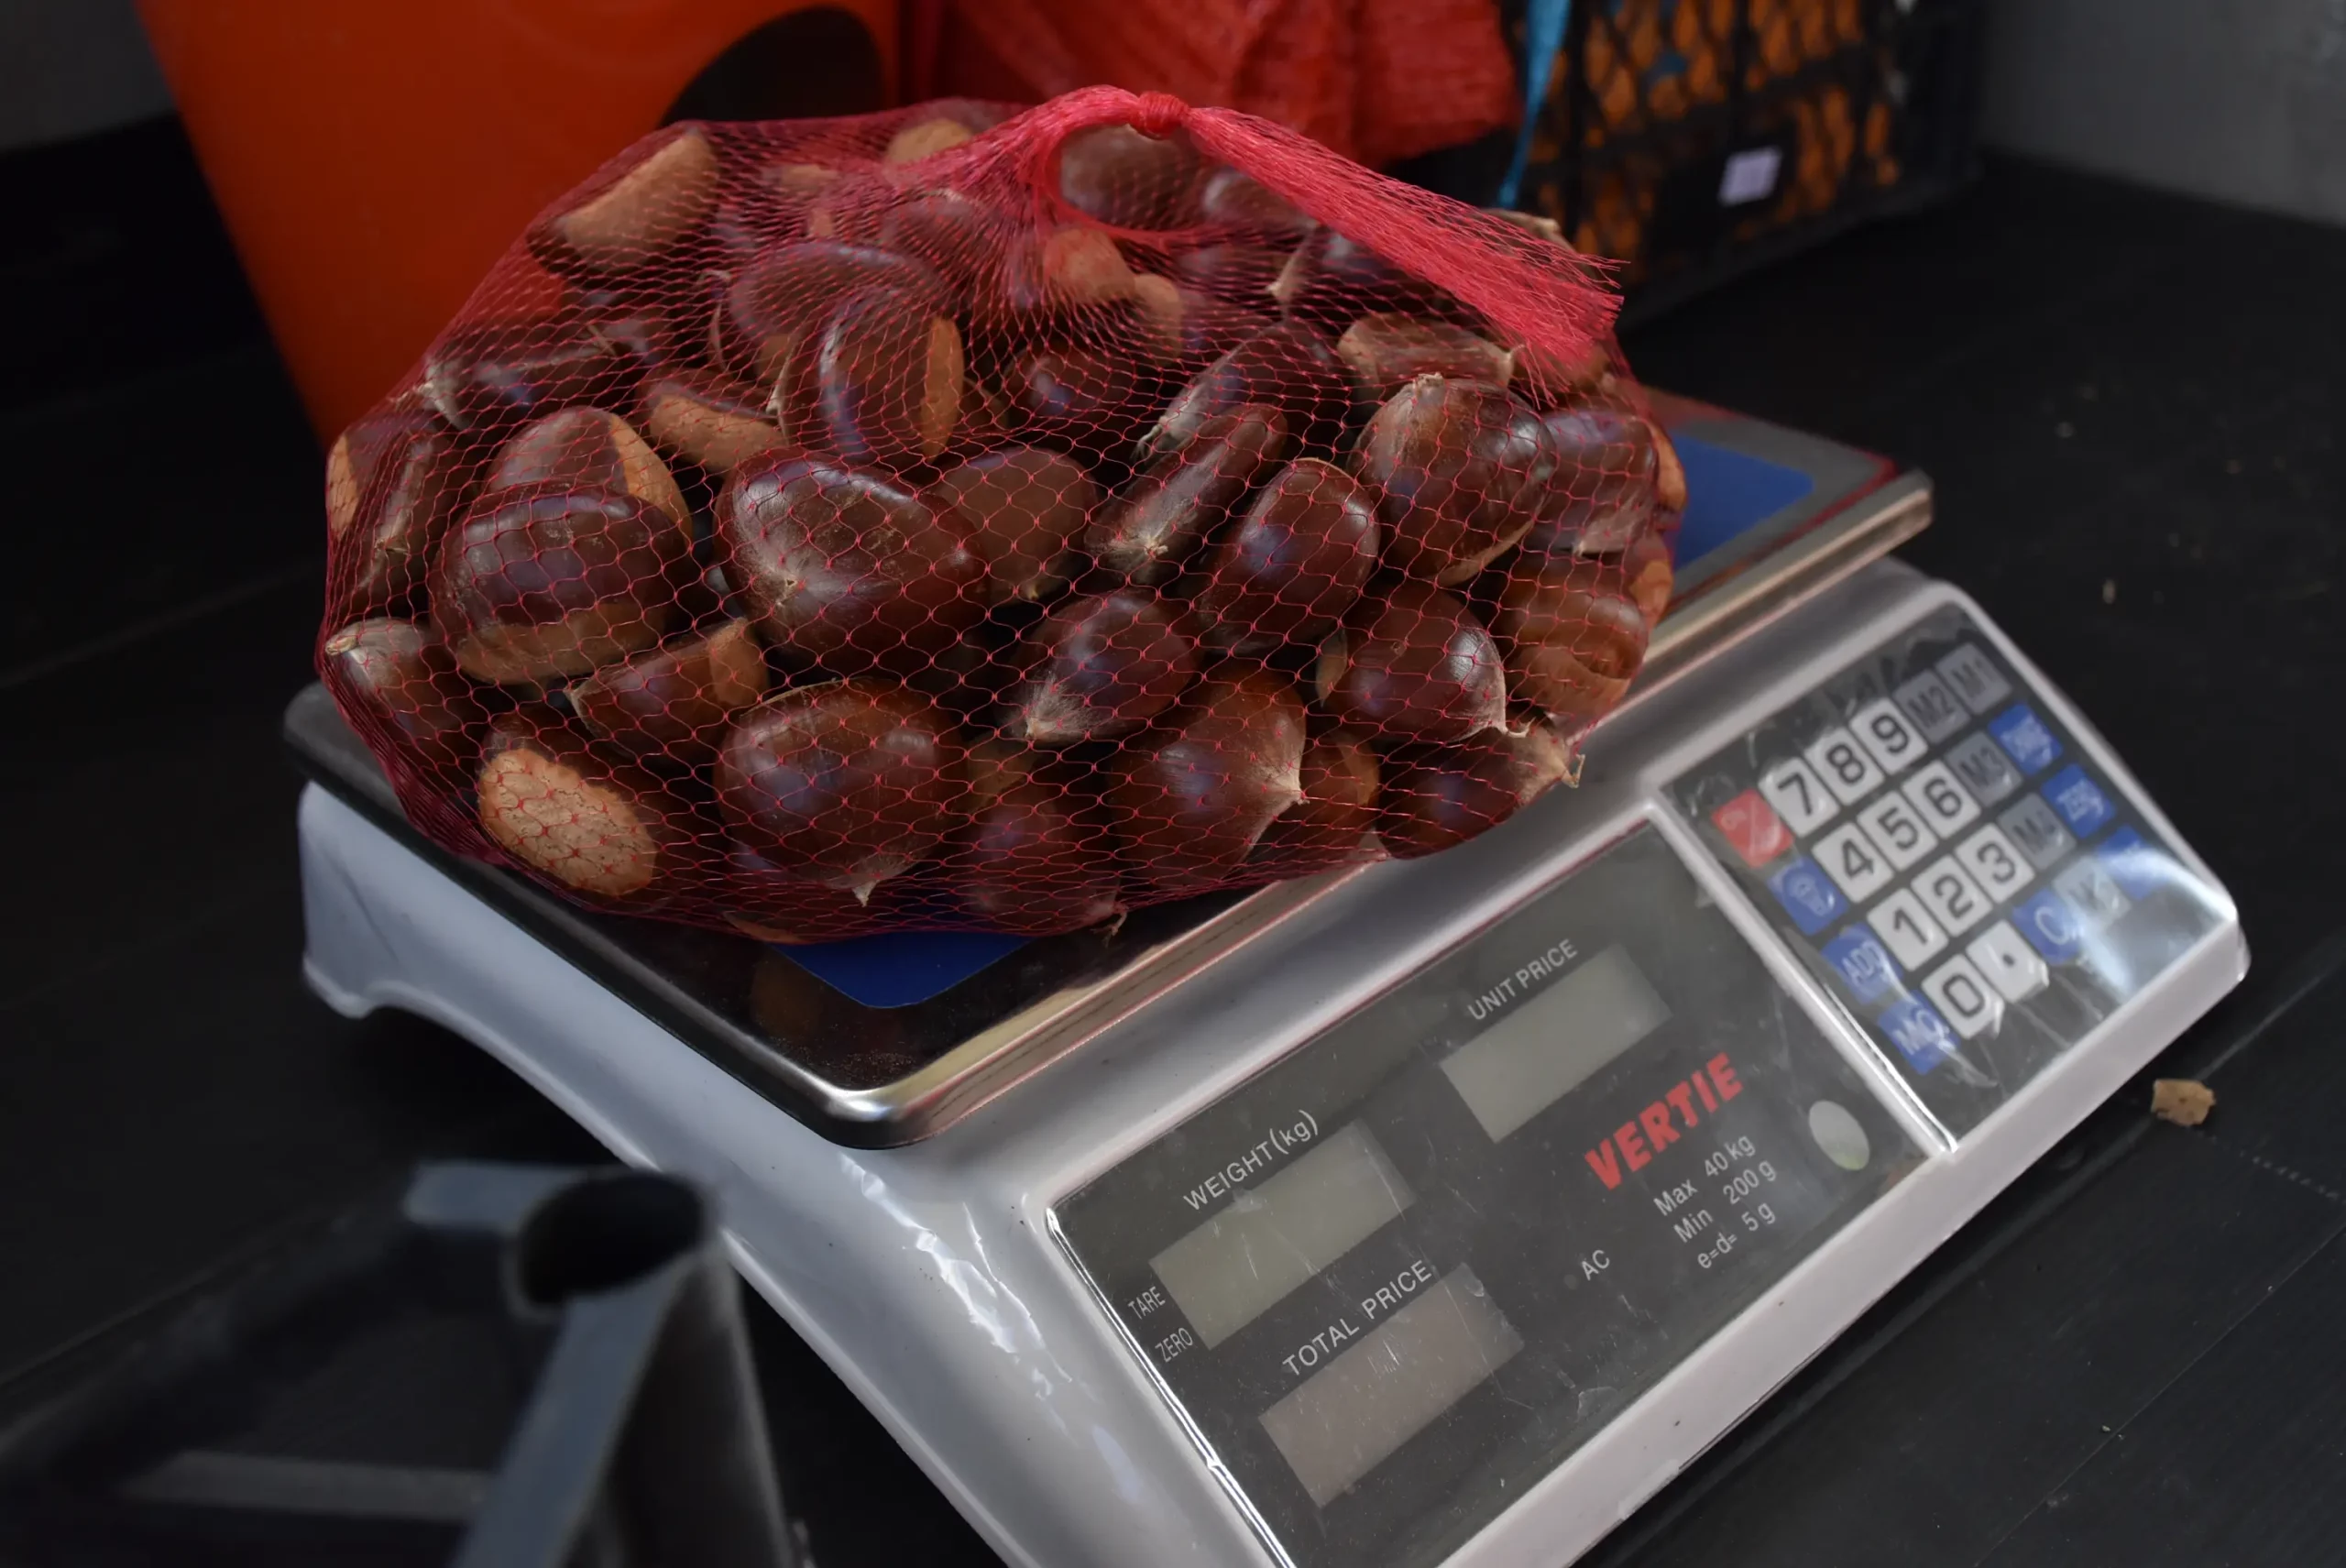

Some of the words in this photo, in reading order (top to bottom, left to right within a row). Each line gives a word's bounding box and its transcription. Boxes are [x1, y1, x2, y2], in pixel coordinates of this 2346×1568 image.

[1907, 685, 1955, 729] M2
[1871, 715, 1909, 755] 9
[1825, 743, 1865, 784] 8
[1958, 745, 2005, 787] M3
[1777, 772, 1813, 817] 7
[1924, 776, 1962, 819] 6
[1877, 806, 1918, 850] 5
[1841, 839, 1875, 878] 4
[1977, 839, 2016, 884] 3
[1933, 874, 1974, 920] 2
[1892, 906, 1928, 946] 1
[1467, 977, 1517, 1020] UNIT
[1515, 938, 1578, 989] PRICE
[1841, 939, 1890, 986] ADD
[1942, 973, 1985, 1019] 0
[1584, 1051, 1744, 1190] VERTIE
[1182, 1109, 1319, 1211] WEIGHT(kg)
[1653, 1179, 1698, 1216] Max
[1704, 1151, 1729, 1177] 40
[1724, 1135, 1756, 1160] kg
[1673, 1208, 1714, 1243] Min
[1723, 1168, 1760, 1204] 200
[1758, 1160, 1777, 1182] g
[1741, 1212, 1760, 1232] 5
[1758, 1202, 1776, 1224] g
[1581, 1249, 1611, 1281] AC
[1127, 1286, 1167, 1320] TARE
[1282, 1318, 1360, 1376] TOTAL
[1361, 1260, 1432, 1320] PRICE
[1155, 1327, 1194, 1363] ZERO
